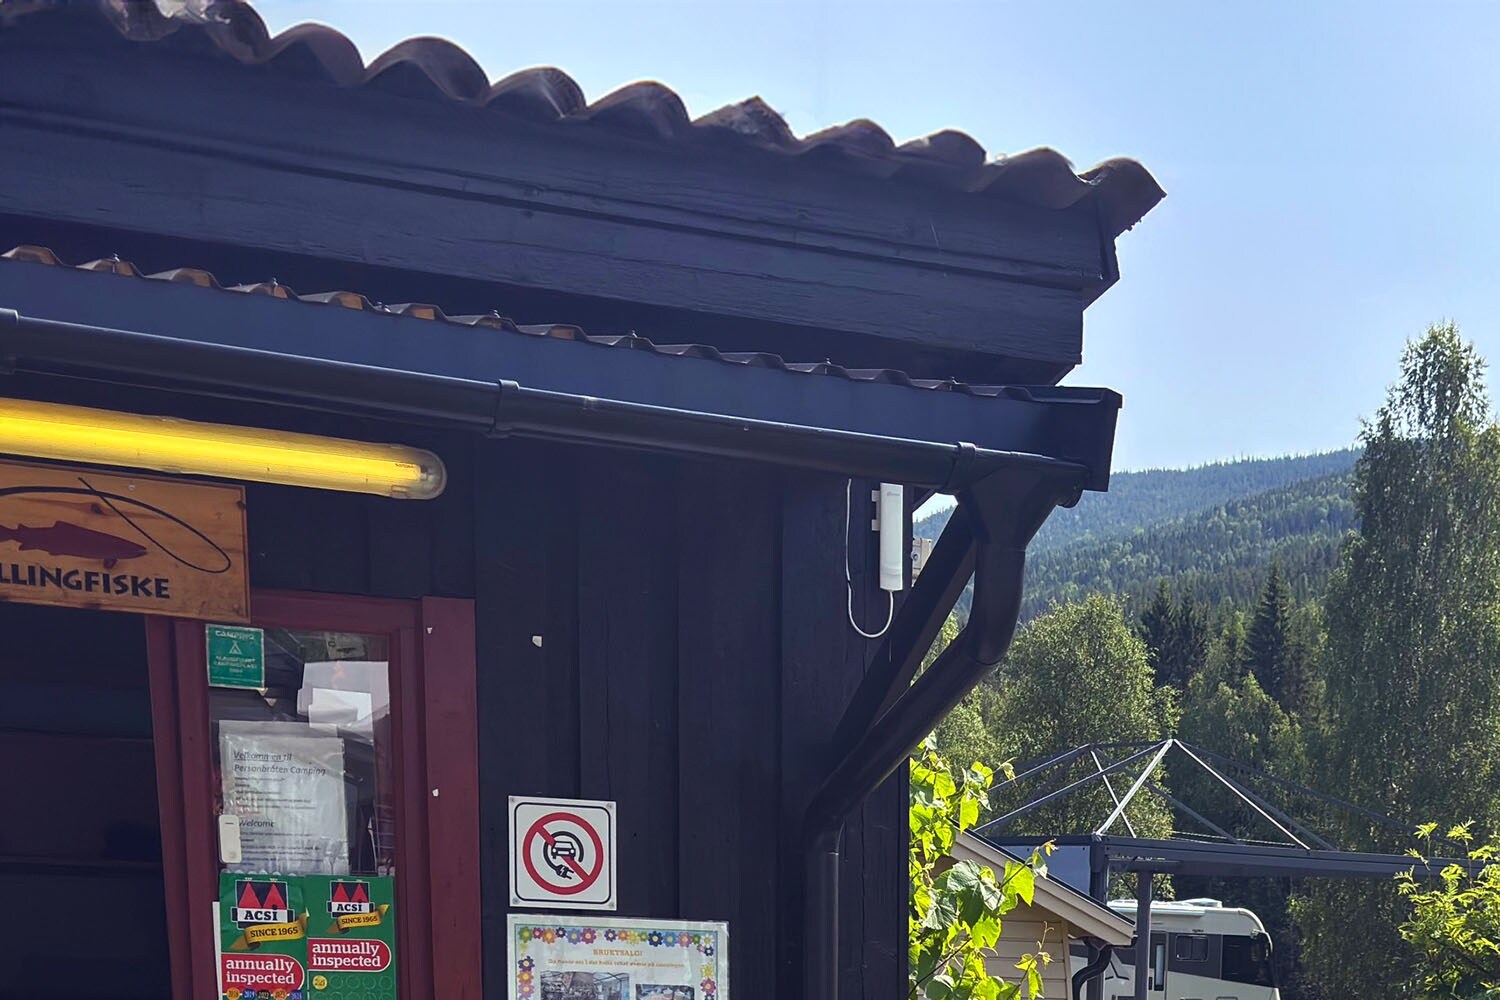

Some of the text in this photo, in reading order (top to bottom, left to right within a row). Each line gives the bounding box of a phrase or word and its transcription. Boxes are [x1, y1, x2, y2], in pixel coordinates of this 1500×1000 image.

[290, 766, 326, 776] Camping
[341, 915, 379, 925] SINCE 1965
[250, 926, 299, 938] SINCE 1965
[312, 941, 380, 957] annually
[225, 958, 295, 974] annually
[312, 954, 381, 969] inspected
[225, 971, 296, 986] inspected
